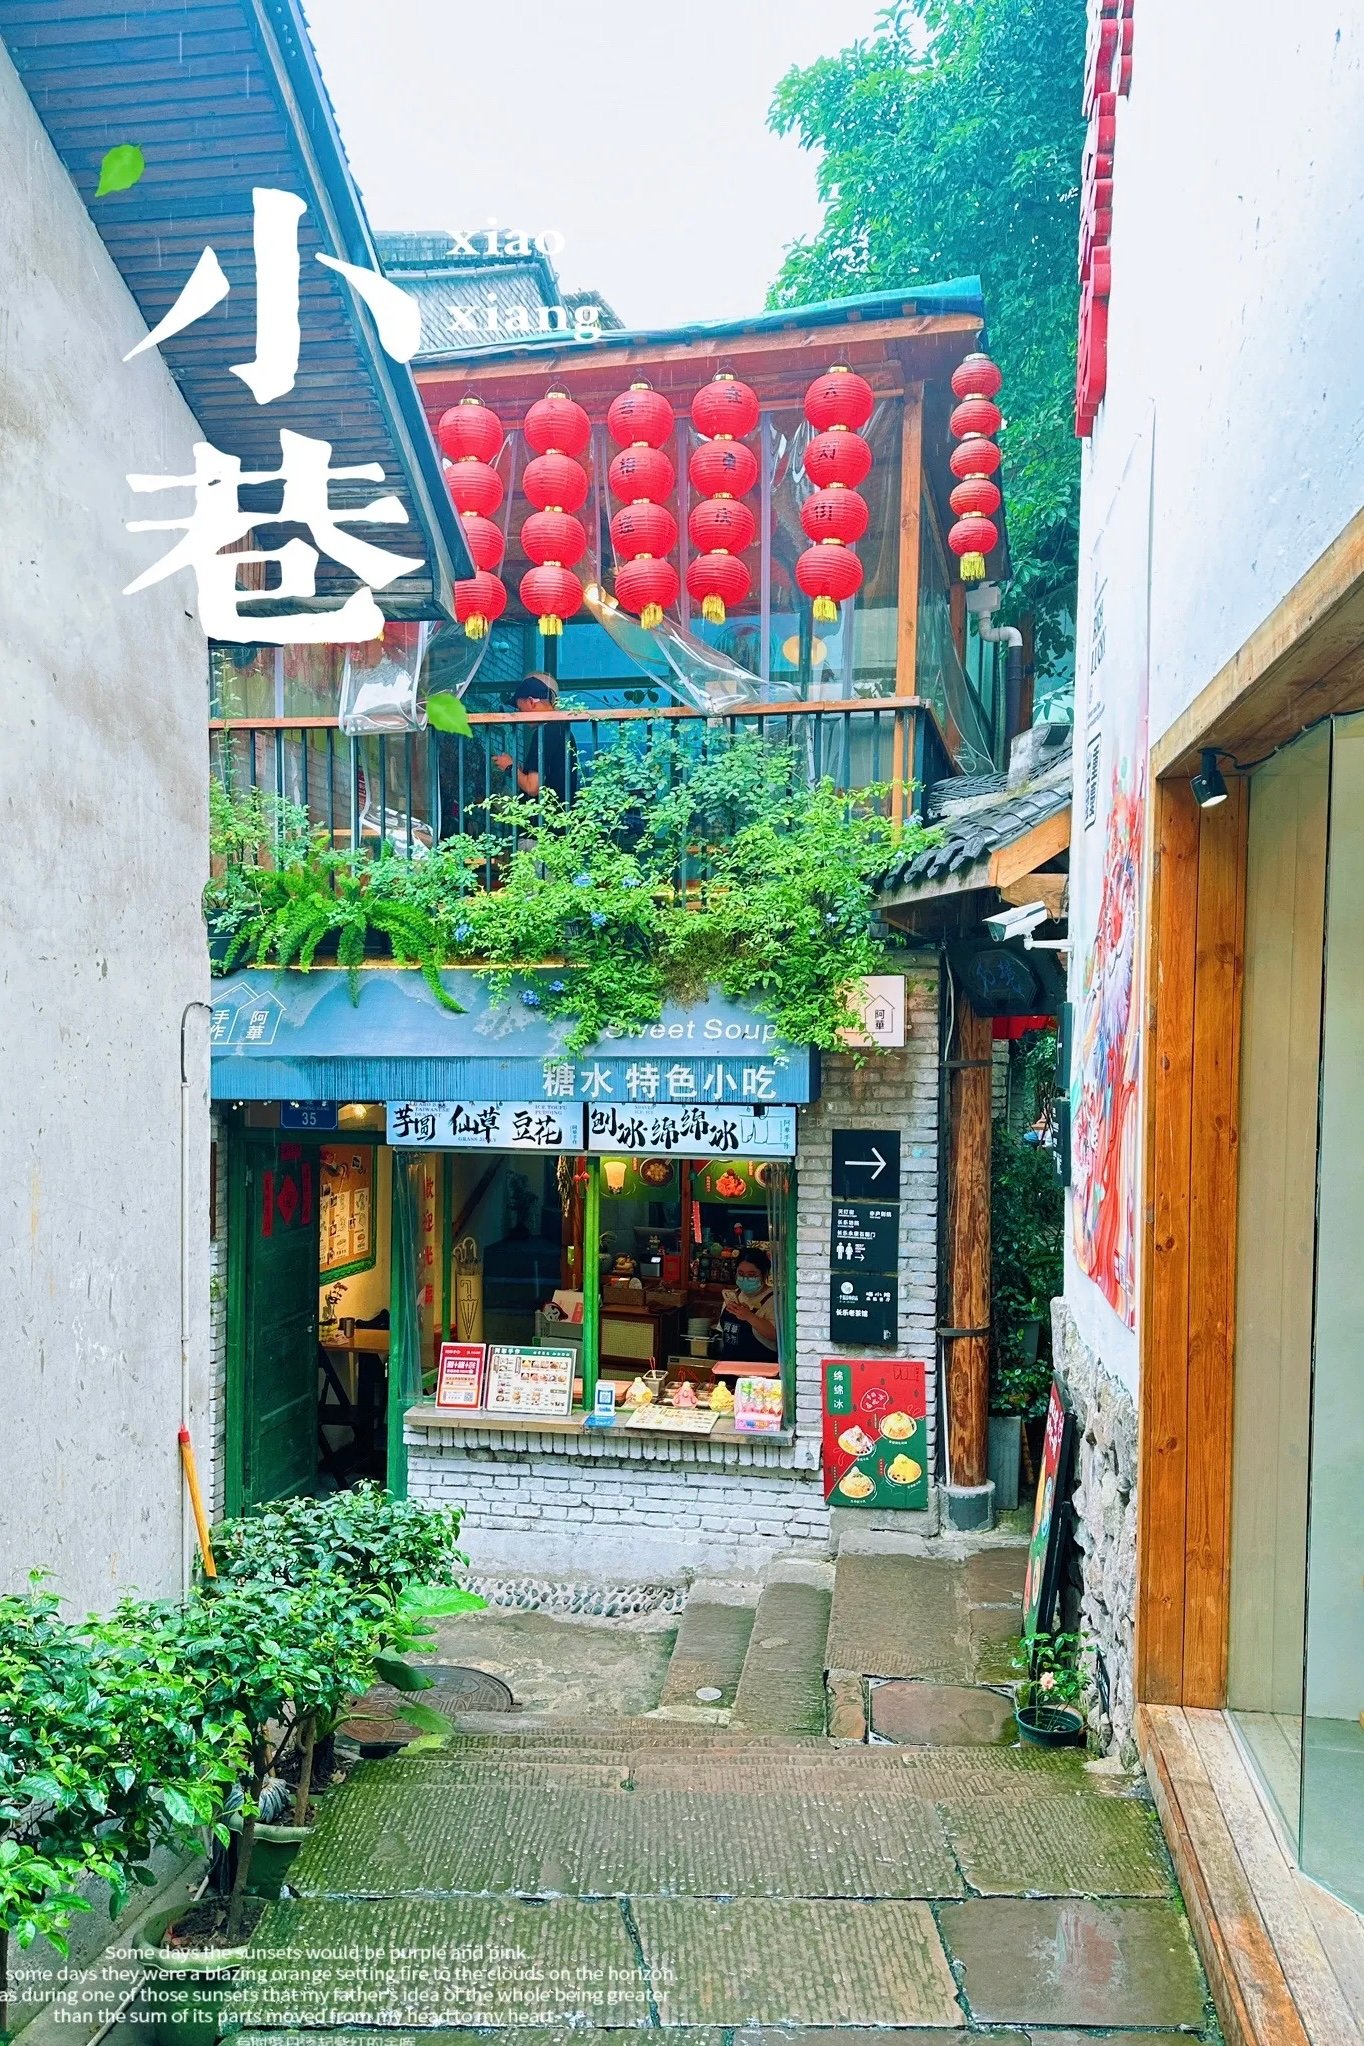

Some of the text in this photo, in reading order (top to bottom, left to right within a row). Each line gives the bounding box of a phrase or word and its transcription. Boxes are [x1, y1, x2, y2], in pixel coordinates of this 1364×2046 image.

[210, 1009, 230, 1040] 手作
[245, 1010, 270, 1041] 阿華
[704, 1018, 778, 1044] Soup
[874, 1009, 885, 1030] 阿華
[542, 1062, 778, 1100] 糖水 特色小吃
[302, 1112, 317, 1125] 35
[449, 1104, 501, 1144] 仙草
[512, 1110, 562, 1146] 豆花
[833, 1370, 844, 1409] 绵绵冰
